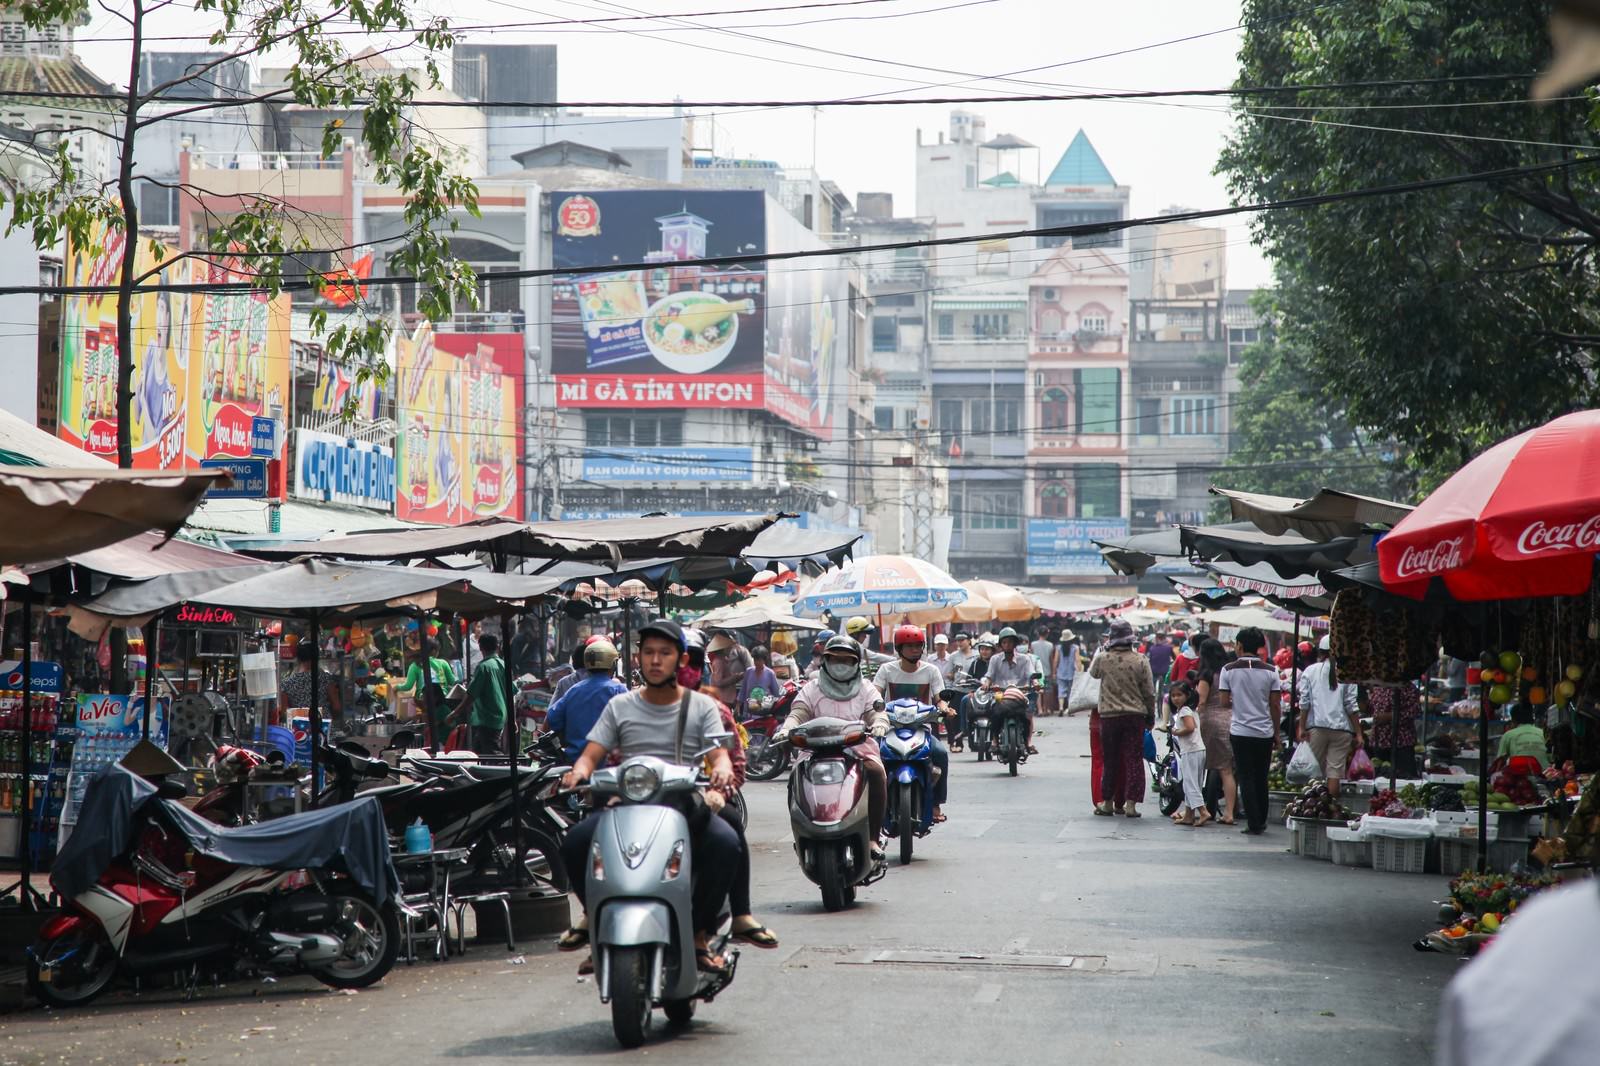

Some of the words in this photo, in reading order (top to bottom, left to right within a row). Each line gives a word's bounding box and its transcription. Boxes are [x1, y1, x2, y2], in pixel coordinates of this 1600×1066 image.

[568, 210, 591, 225] 50
[561, 379, 588, 401] MÌ
[594, 378, 628, 401] GÀ
[631, 378, 674, 401] TÍM
[679, 382, 753, 402] VIFON
[586, 466, 610, 476] BAN
[247, 476, 263, 490] CÁC
[1517, 514, 1600, 554] Coca-C
[1397, 536, 1465, 578] Coca-Cola
[872, 578, 916, 587] JUMBO
[826, 596, 855, 606] JUMBO
[177, 604, 213, 623] Sinh
